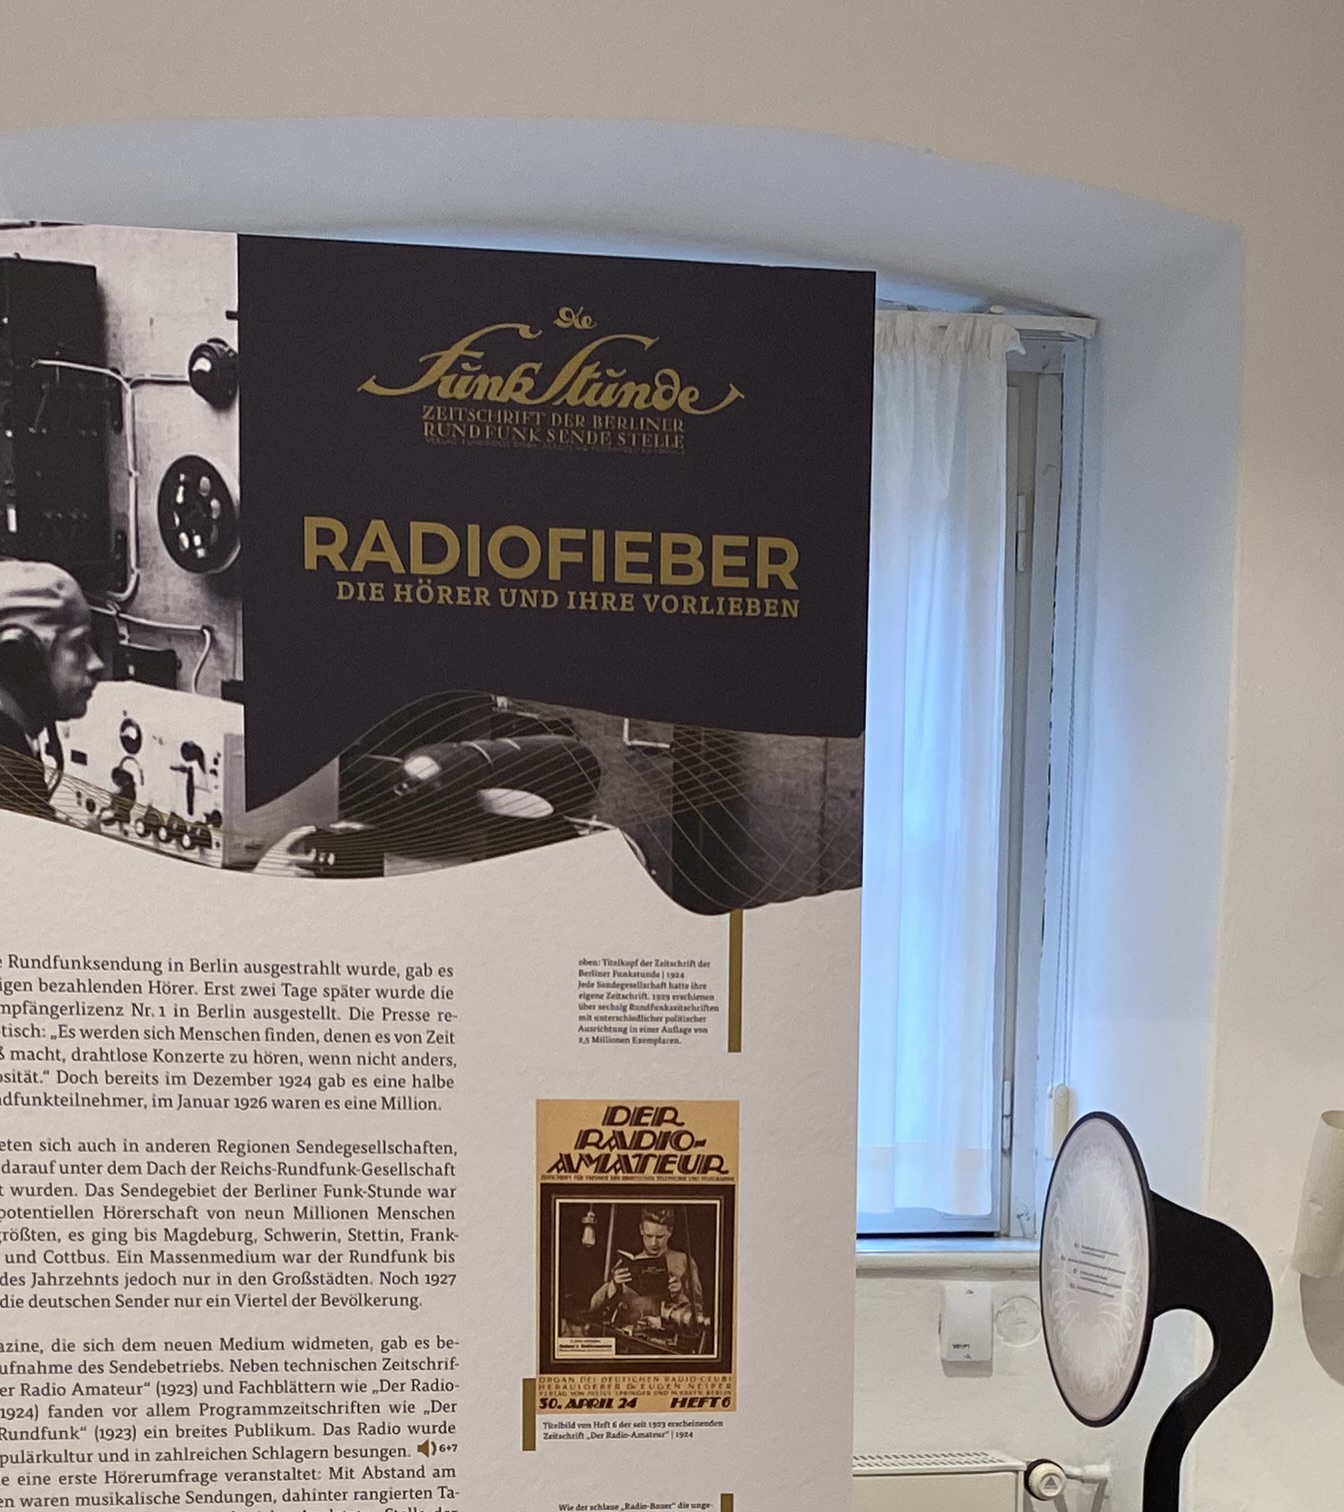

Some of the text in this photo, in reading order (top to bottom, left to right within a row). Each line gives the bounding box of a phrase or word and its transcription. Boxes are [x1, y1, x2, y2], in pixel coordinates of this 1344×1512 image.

[422, 404, 684, 433] ZEITSCHRIFT DER BERLINER
[303, 516, 800, 590] RADIOFIEBER
[336, 578, 800, 618] DIE HÖRER UND IHRE VORLIEBEN
[8, 953, 163, 976] Rundfunksendung
[168, 957, 185, 973] in
[189, 957, 239, 974] Berlin
[243, 959, 341, 979] ausgestrahlt
[346, 960, 400, 979] wurde,
[405, 962, 433, 982] gab
[437, 966, 454, 978] es
[38, 977, 143, 995] bezahlenden
[148, 979, 198, 996] Hörer.
[204, 981, 235, 997] Erst
[240, 982, 276, 997] zwei
[280, 982, 318, 1002] Tage
[322, 984, 371, 1002] später
[375, 984, 425, 1000] wurde
[430, 984, 454, 1000] die
[131, 1002, 155, 1018] Nr.
[173, 1003, 190, 1018] in
[197, 1003, 246, 1019] Berlin
[253, 1005, 341, 1025] ausgestellt.
[349, 1006, 375, 1022] Die
[381, 1006, 431, 1023] Presse
[437, 1011, 458, 1023] re-
[601, 1105, 685, 1127] DER
[574, 1128, 707, 1152] RADIO-
[546, 1152, 729, 1175] AMATEUR
[565, 1398, 614, 1409] APRIL
[617, 1397, 640, 1409] 24
[670, 1397, 721, 1409] HEFT
[722, 1397, 731, 1409] 6
